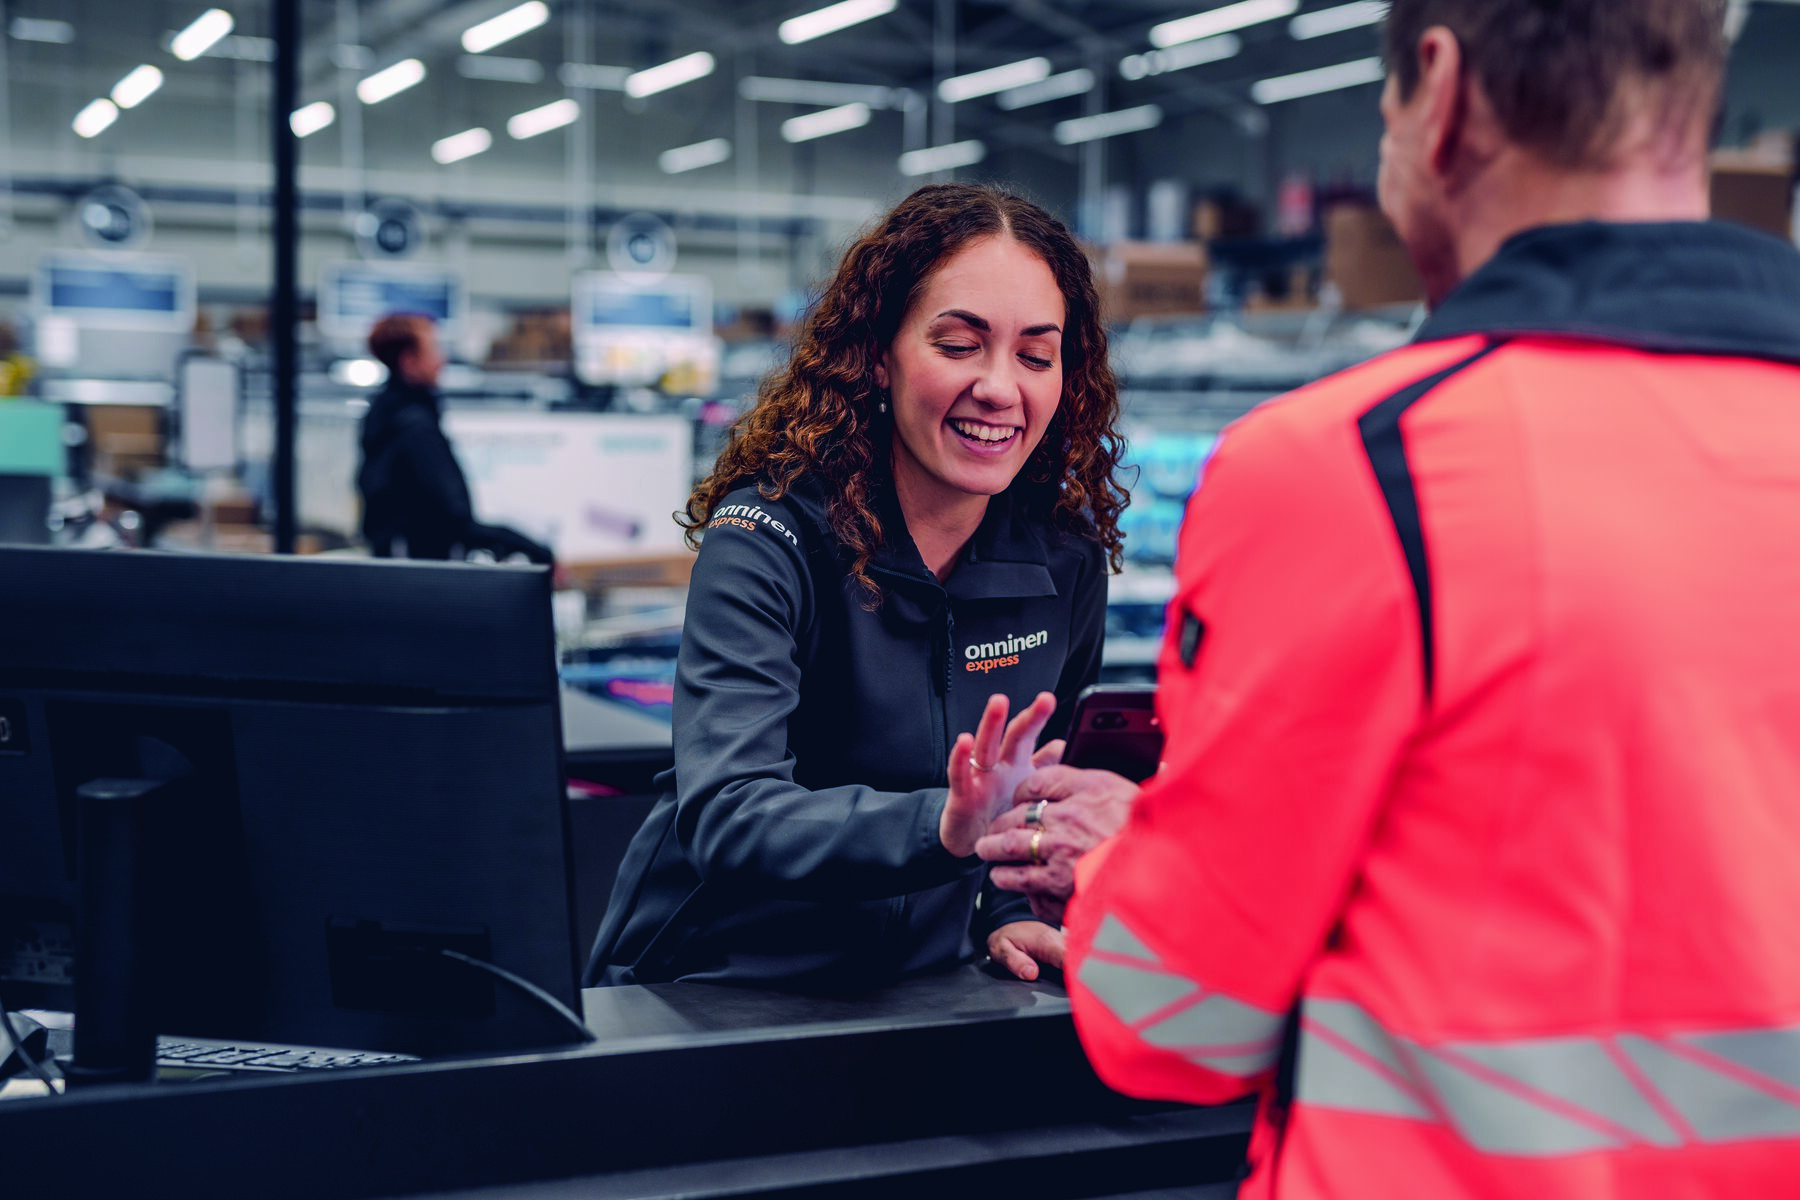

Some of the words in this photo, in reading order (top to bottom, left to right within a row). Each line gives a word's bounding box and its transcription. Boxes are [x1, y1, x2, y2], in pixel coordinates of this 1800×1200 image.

[708, 516, 757, 532] express
[713, 504, 798, 546] onninen
[965, 630, 1048, 660] onninen
[965, 654, 1020, 674] express
